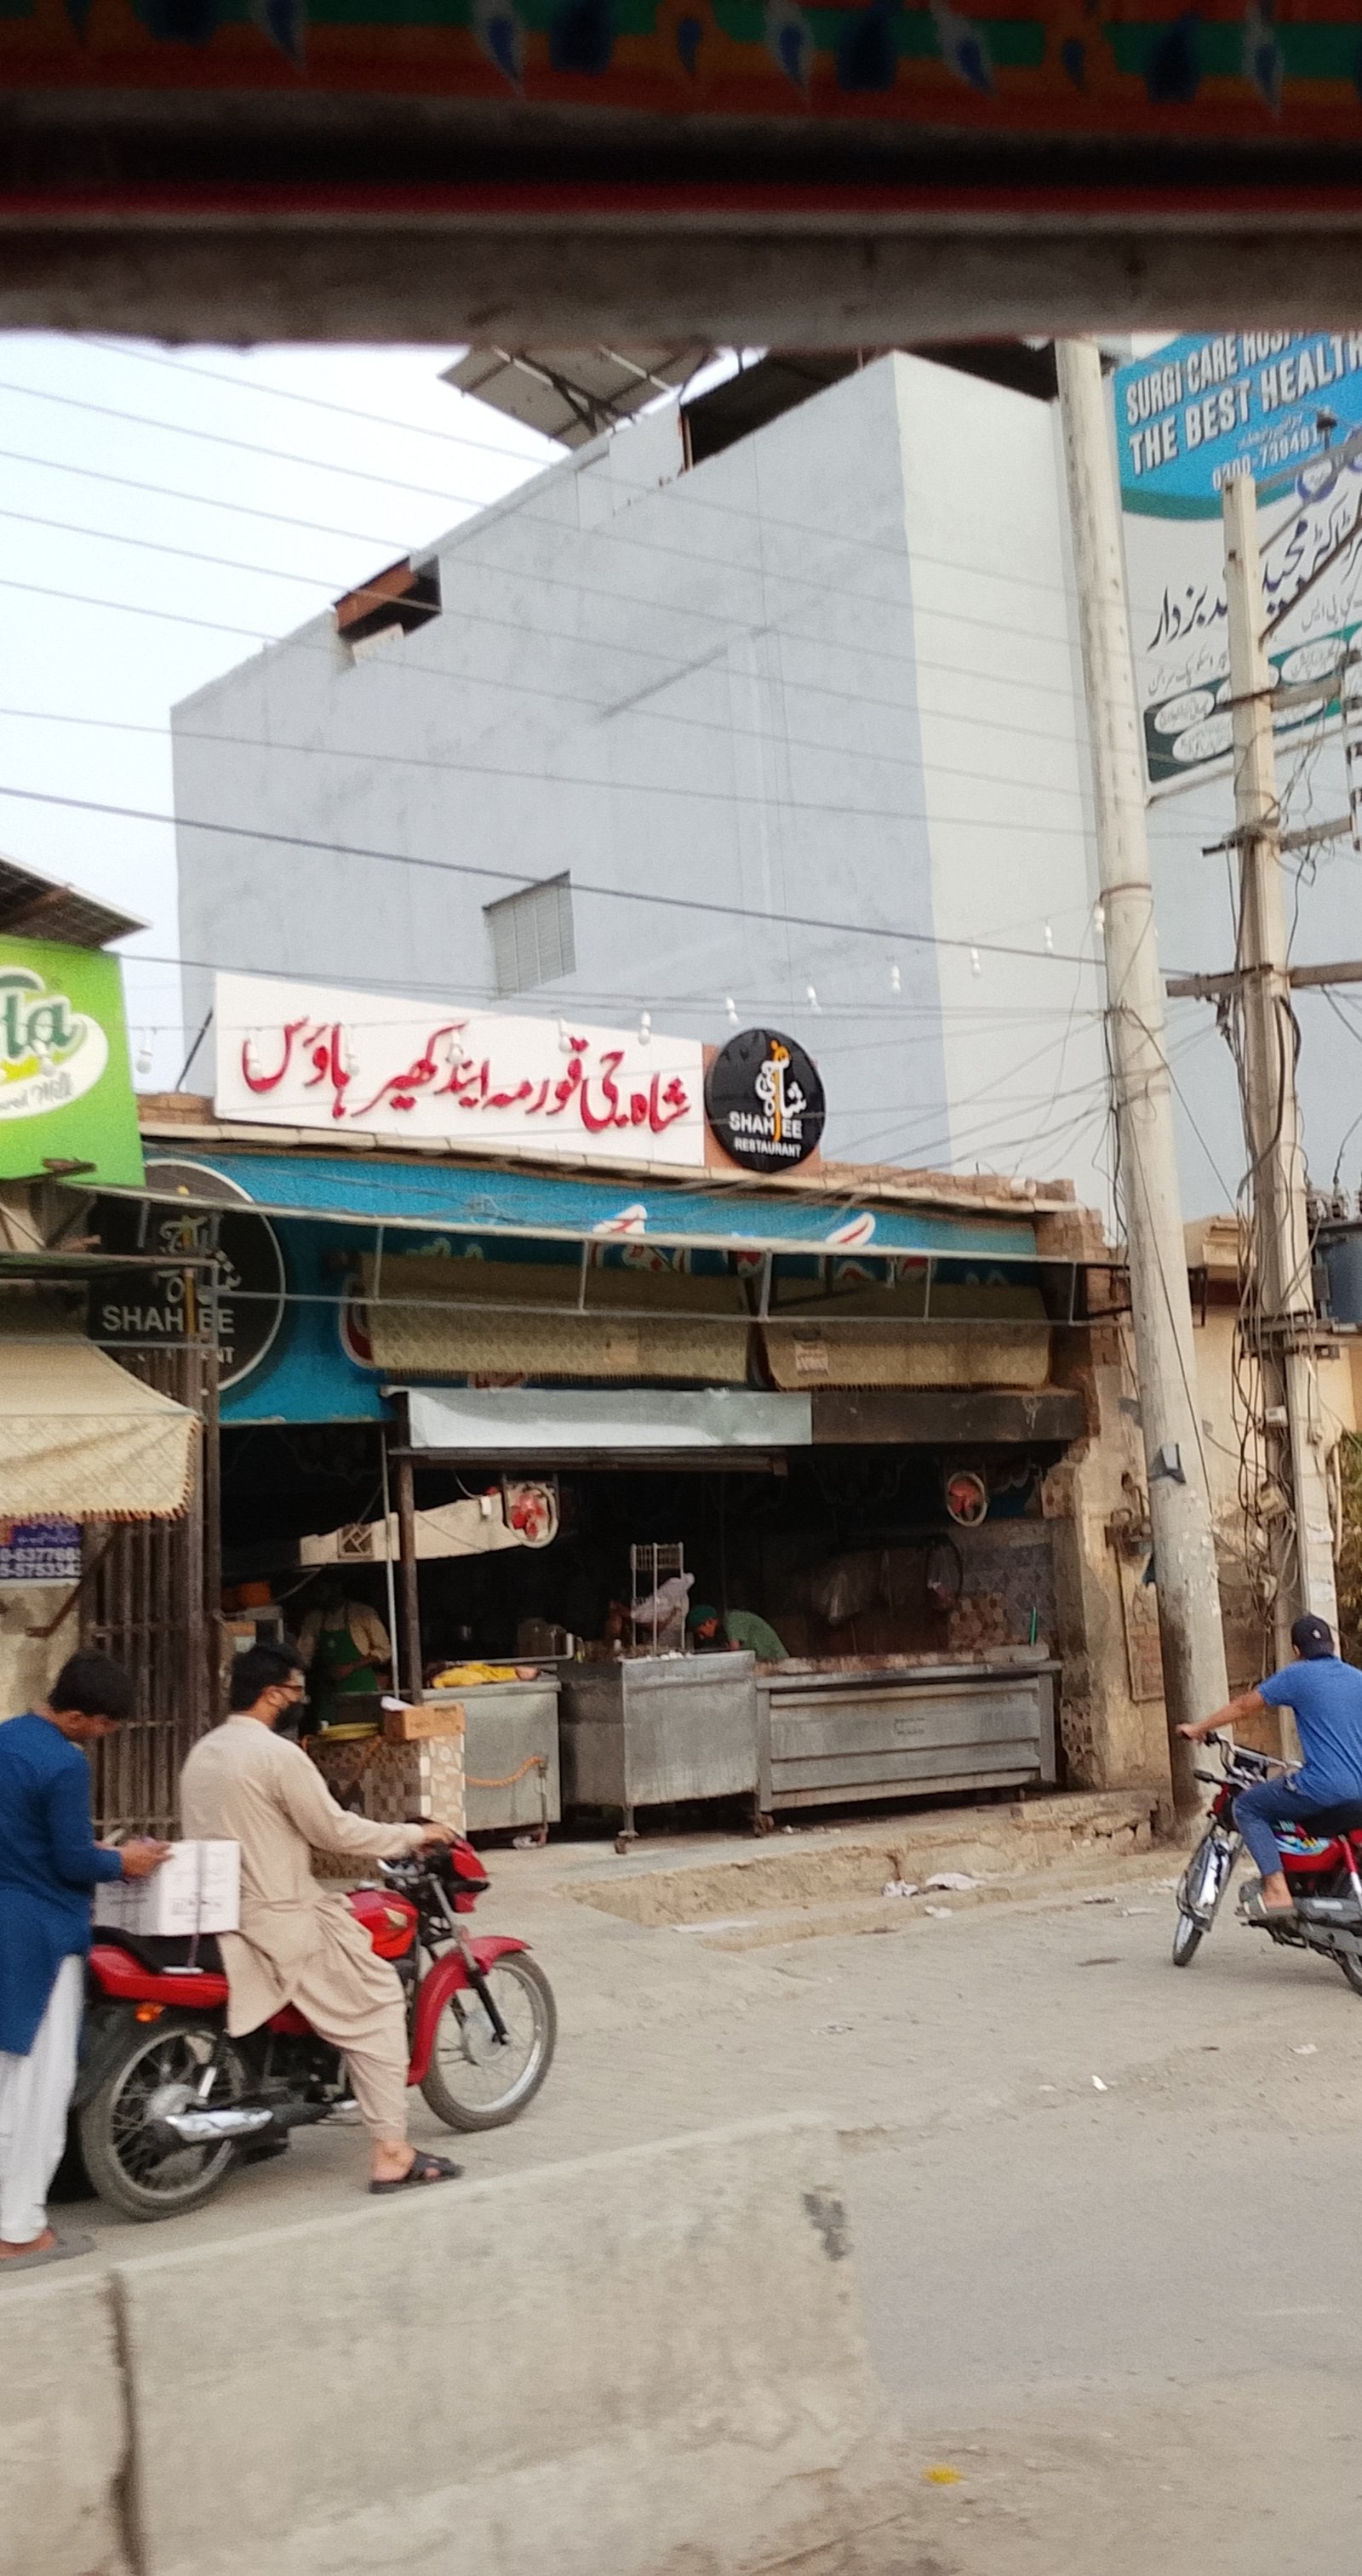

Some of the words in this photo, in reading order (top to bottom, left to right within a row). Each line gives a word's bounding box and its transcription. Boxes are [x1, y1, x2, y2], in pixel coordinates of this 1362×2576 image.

[1125, 361, 1183, 426] SURGI
[1187, 335, 1238, 394] CARE
[1129, 415, 1178, 476] THE
[1185, 378, 1251, 450] BEST
[350, 1019, 469, 1117] کھیر
[482, 1036, 589, 1116] قورمہ
[581, 1051, 629, 1133] جی
[631, 1072, 690, 1133] شاہ
[734, 1136, 802, 1158] RESTAURANT
